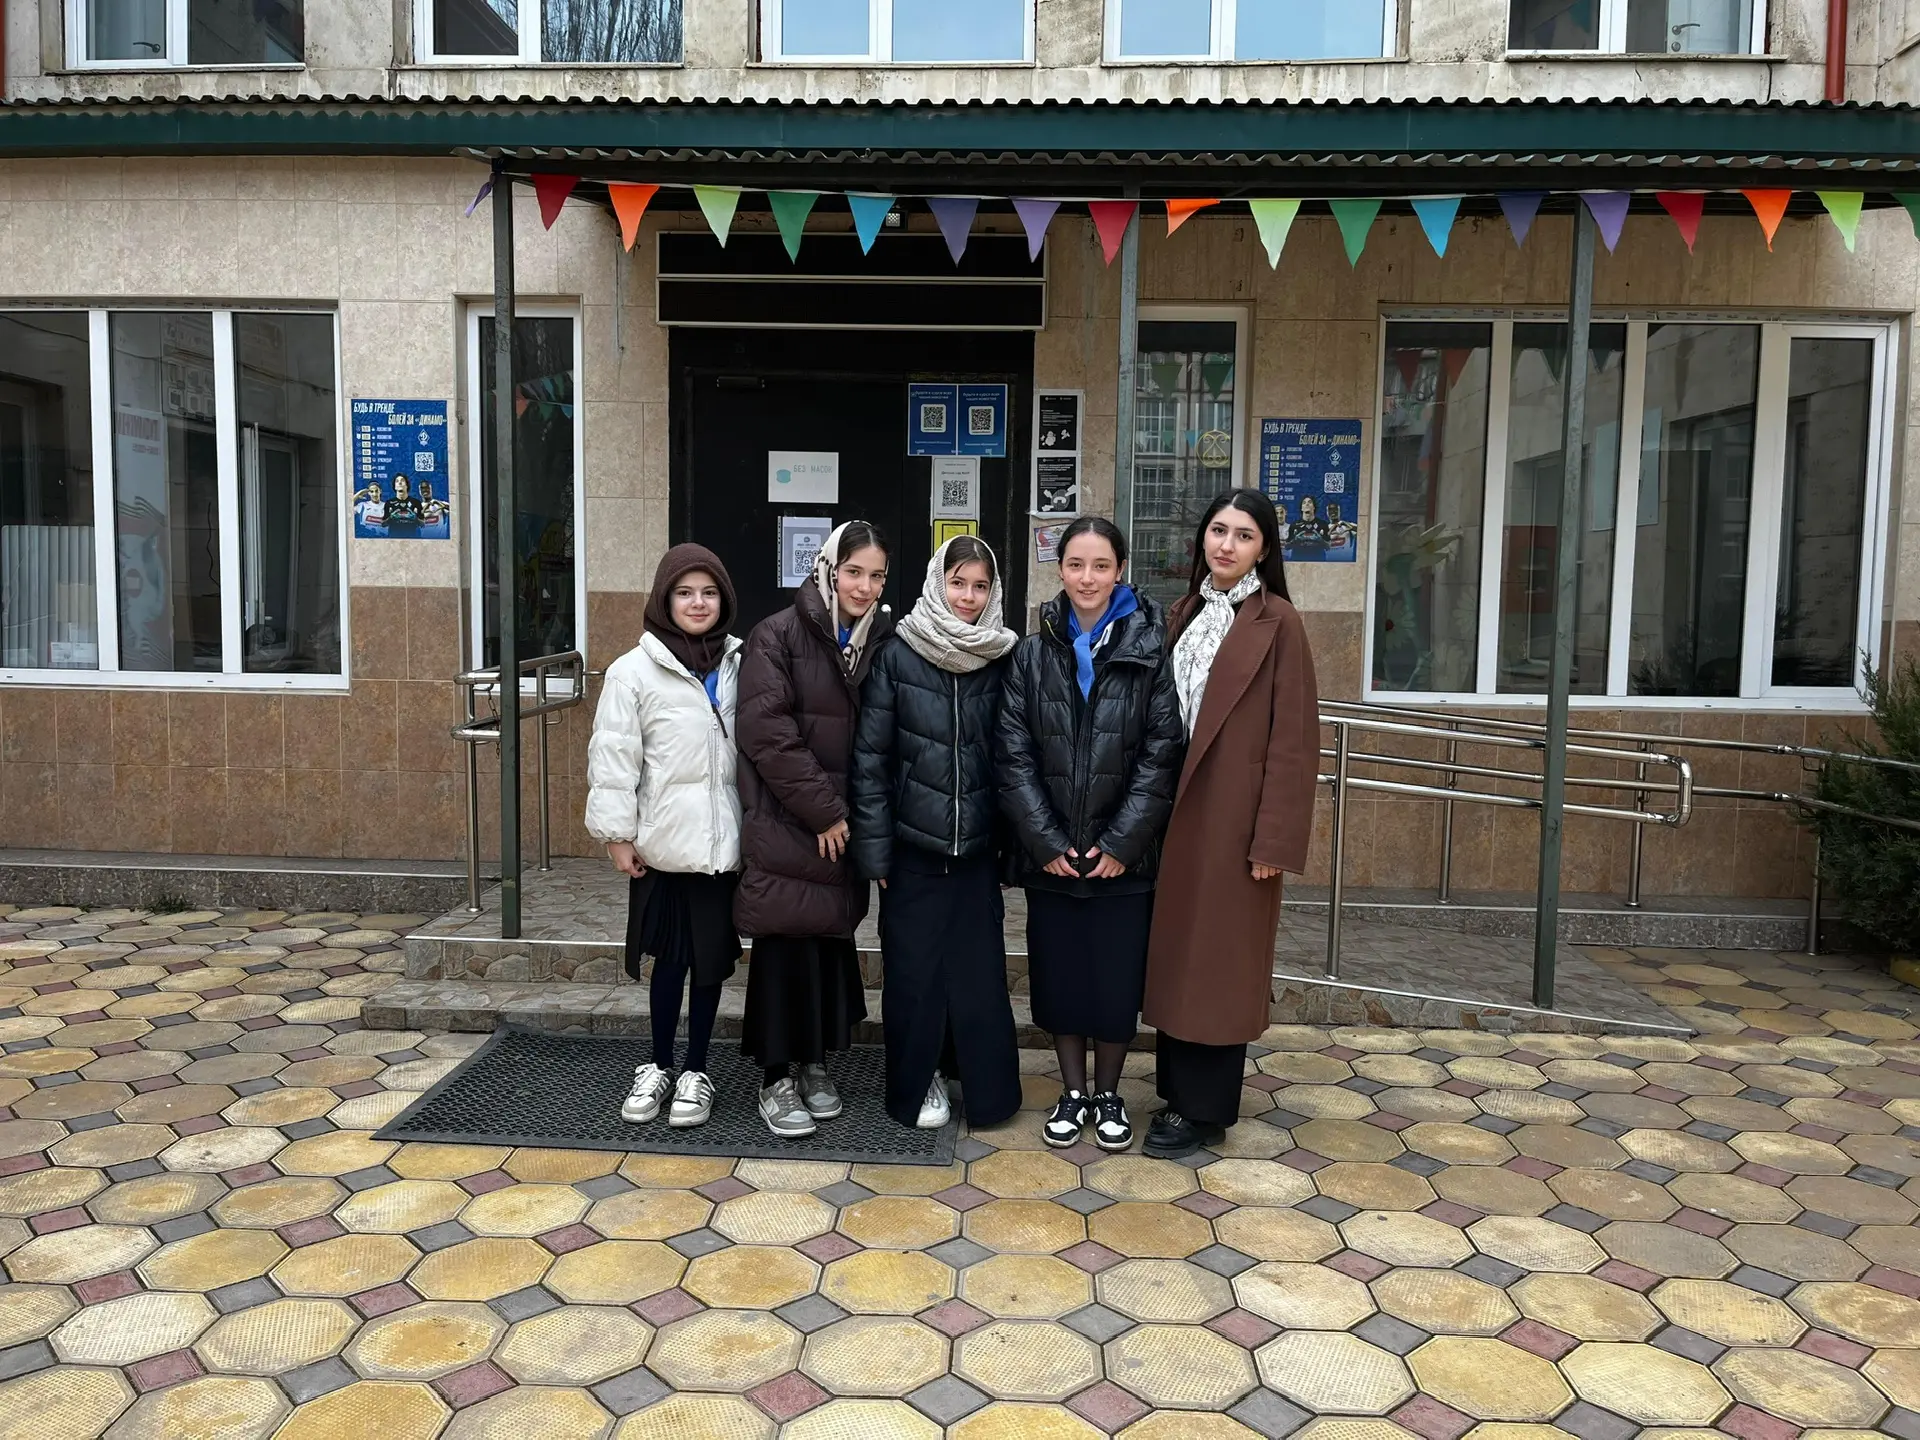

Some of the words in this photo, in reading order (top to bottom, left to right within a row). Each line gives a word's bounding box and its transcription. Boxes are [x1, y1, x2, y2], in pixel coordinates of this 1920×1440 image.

[354, 402, 368, 413] БУДЬ
[369, 403, 374, 412] В
[374, 402, 395, 413] ТРЕНДЕ
[388, 412, 406, 425] БОЛЕЙ
[406, 414, 414, 424] ЗА
[1264, 424, 1279, 434] БУДЬ
[1280, 424, 1284, 433] В
[1285, 424, 1308, 434] ТРЕНДЕ
[1299, 432, 1319, 445] БОЛЕЙ
[1319, 435, 1326, 445] ЗА
[794, 464, 806, 472] БЕЗ
[810, 465, 832, 474] МАСОК
